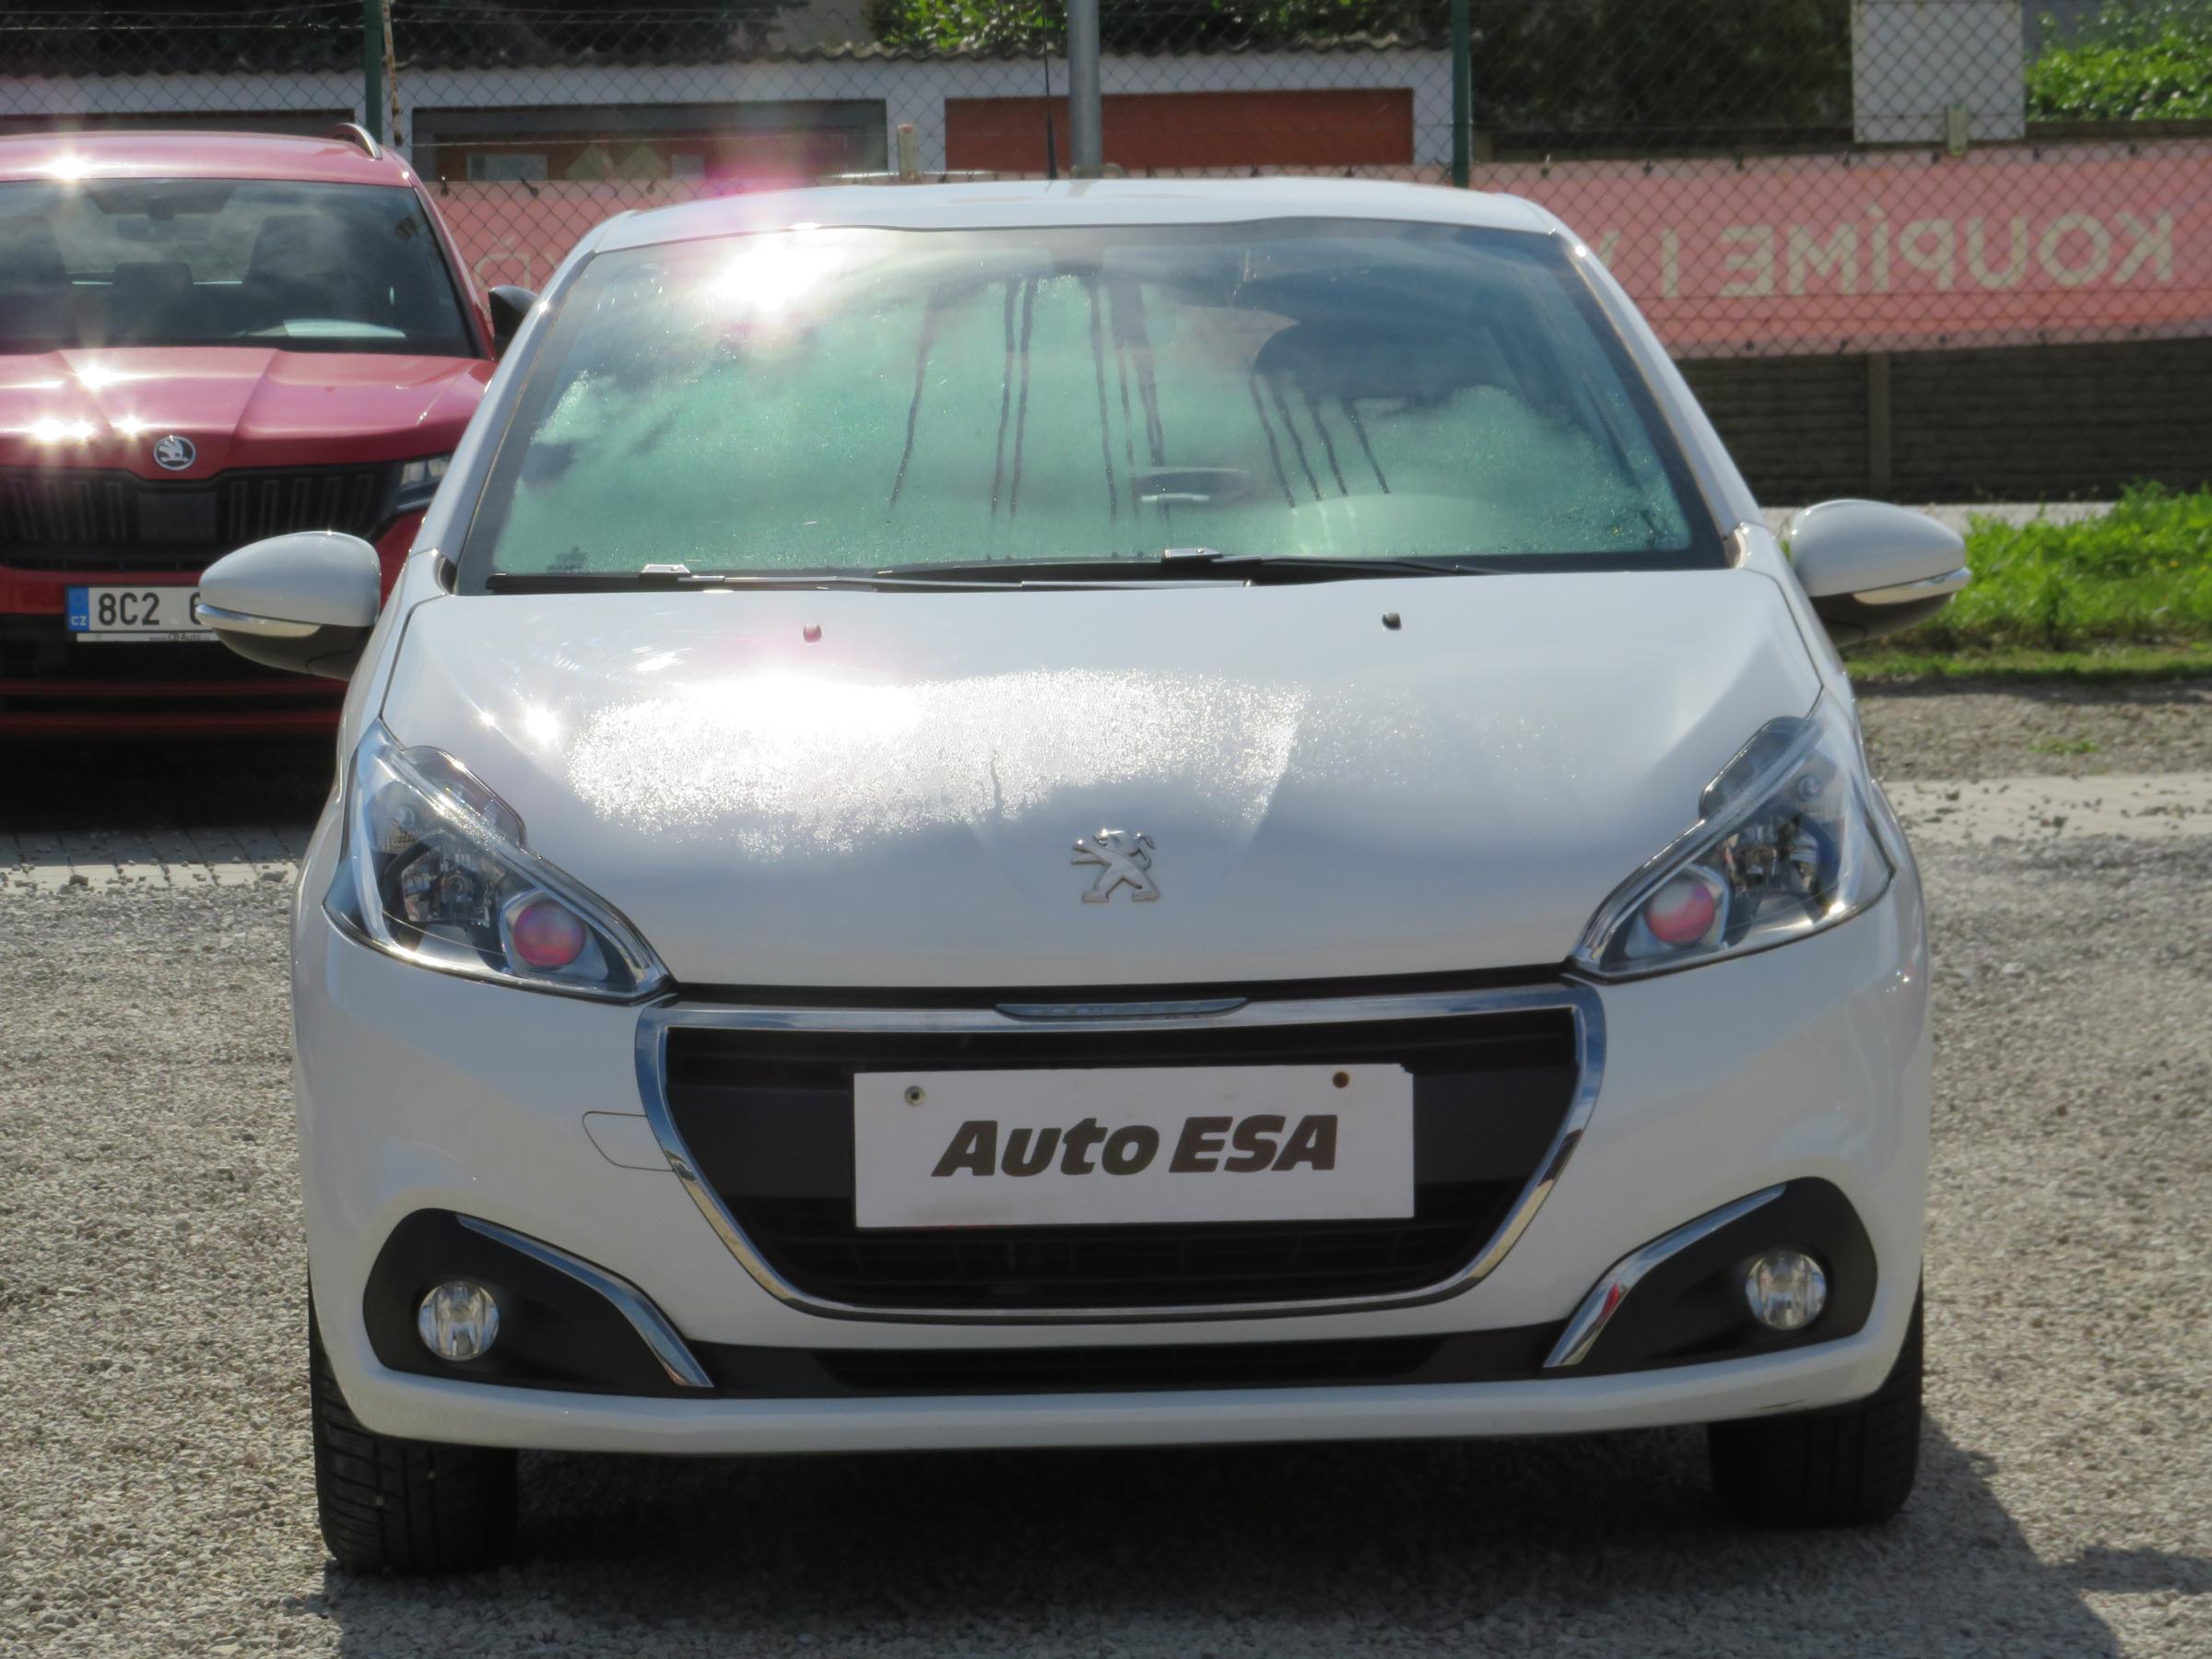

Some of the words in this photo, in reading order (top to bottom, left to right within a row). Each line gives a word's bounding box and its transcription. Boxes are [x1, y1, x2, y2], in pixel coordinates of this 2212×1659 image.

[70, 615, 88, 627] CZ
[98, 592, 160, 626] 8C2
[931, 1117, 1160, 1177] Auto
[1169, 1114, 1338, 1173] ESA
